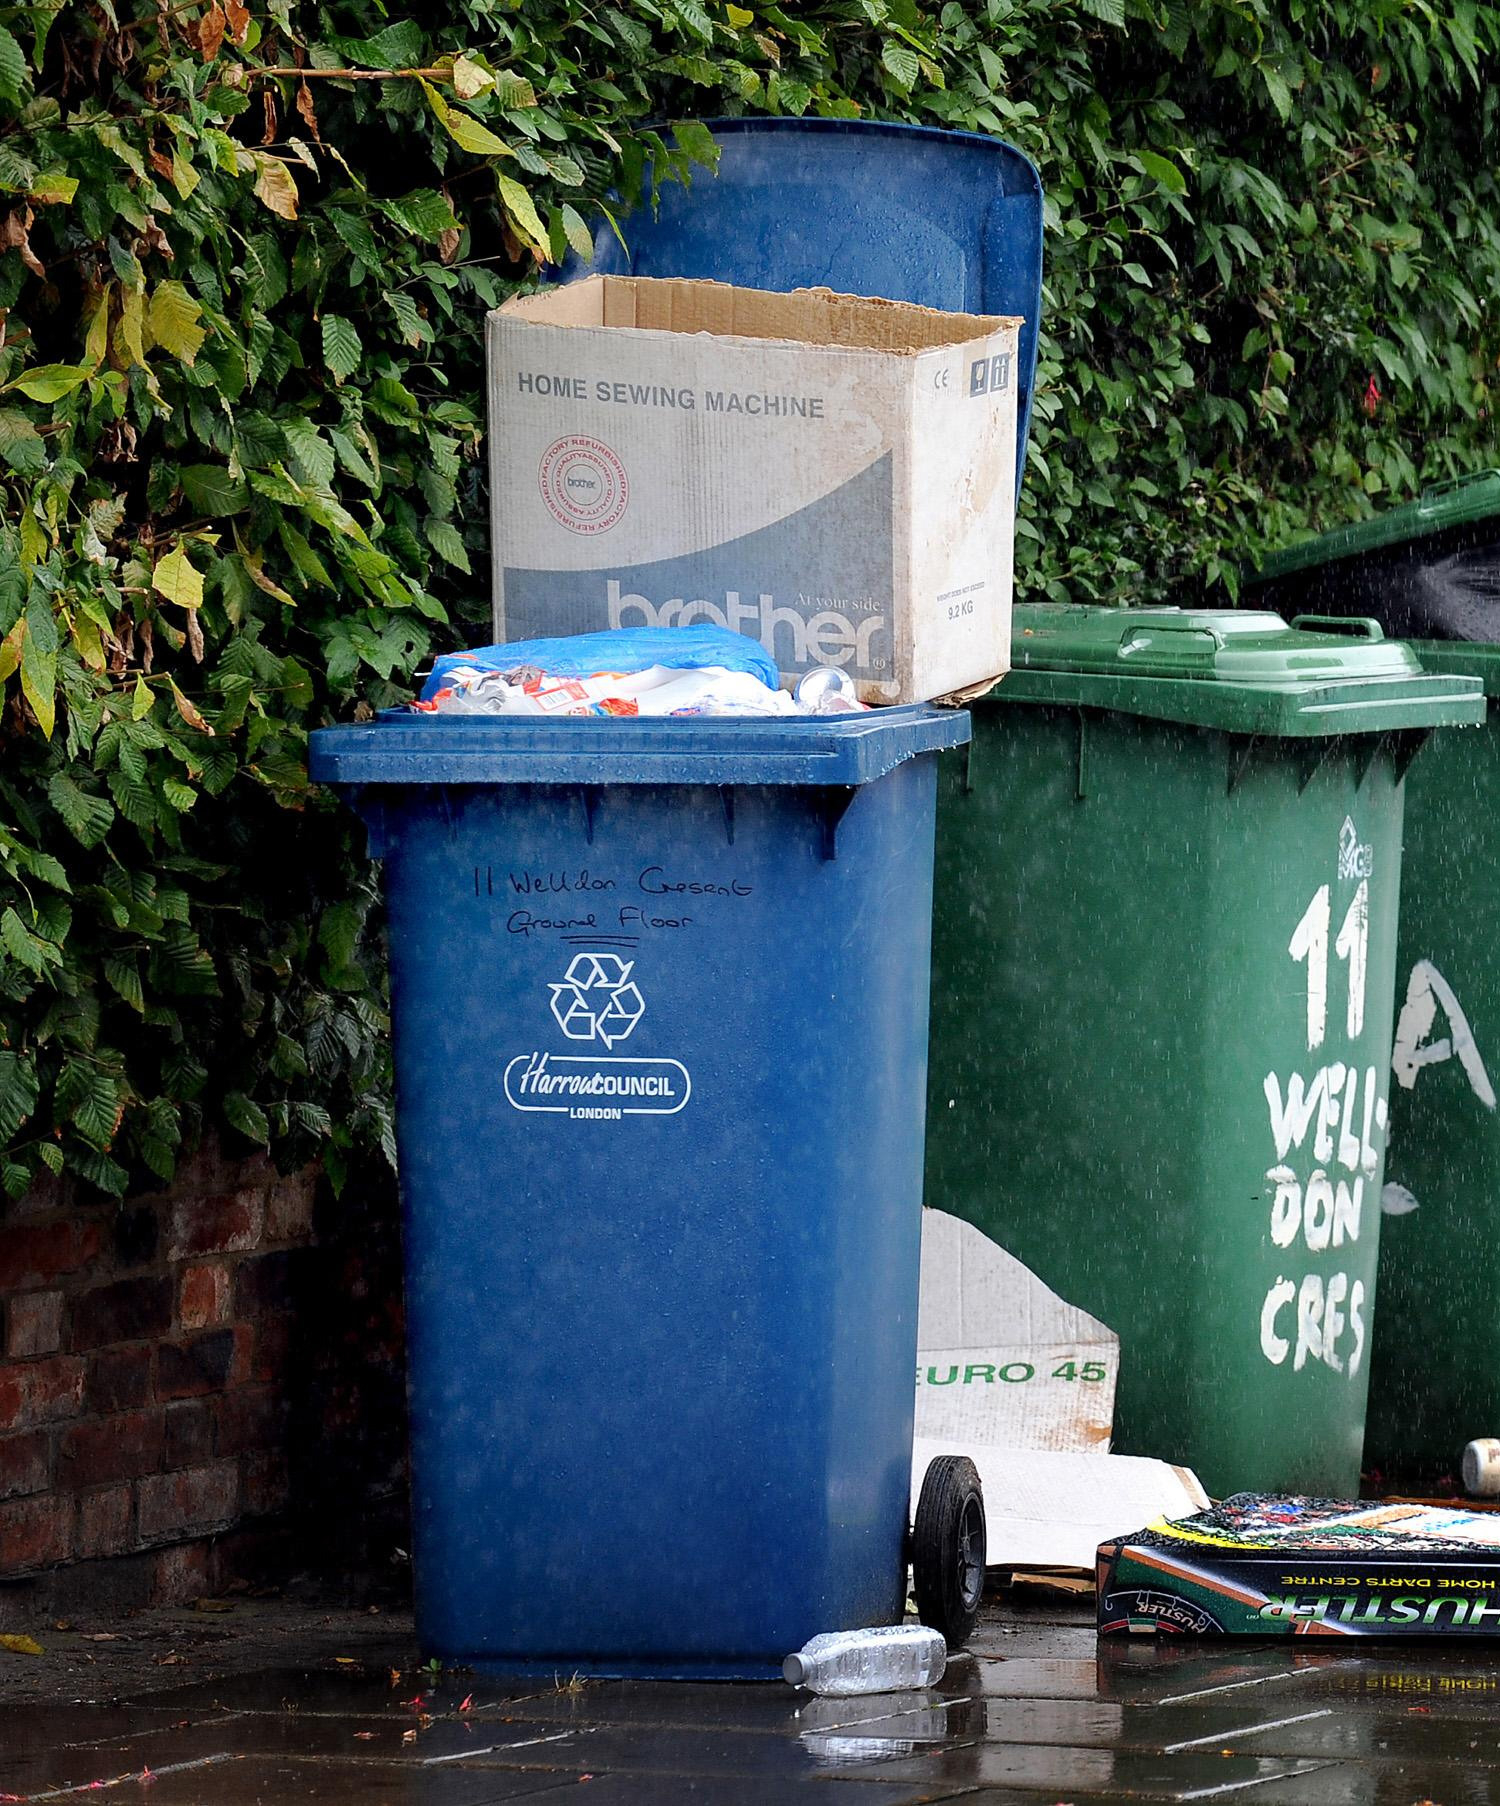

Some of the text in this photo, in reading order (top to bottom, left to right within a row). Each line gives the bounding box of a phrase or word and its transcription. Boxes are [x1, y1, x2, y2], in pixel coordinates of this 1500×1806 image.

[517, 372, 825, 419] HOME SEWING MACHINE
[795, 592, 886, 613] At your side.
[947, 600, 974, 620] 9.2 KG
[509, 869, 616, 894] Welldon
[507, 906, 694, 937] Ground Floor
[1288, 879, 1369, 1052] 11
[1392, 958, 1498, 1109] A
[570, 1107, 622, 1120] LONDON
[1264, 1061, 1378, 1179] WELL
[1266, 1165, 1364, 1252] DON
[1260, 1272, 1365, 1377] CRES
[916, 1361, 1107, 1386] URO 45
[1281, 1575, 1496, 1589] HOME DARTS CENTRE
[1138, 1602, 1206, 1634] HUSTLER
